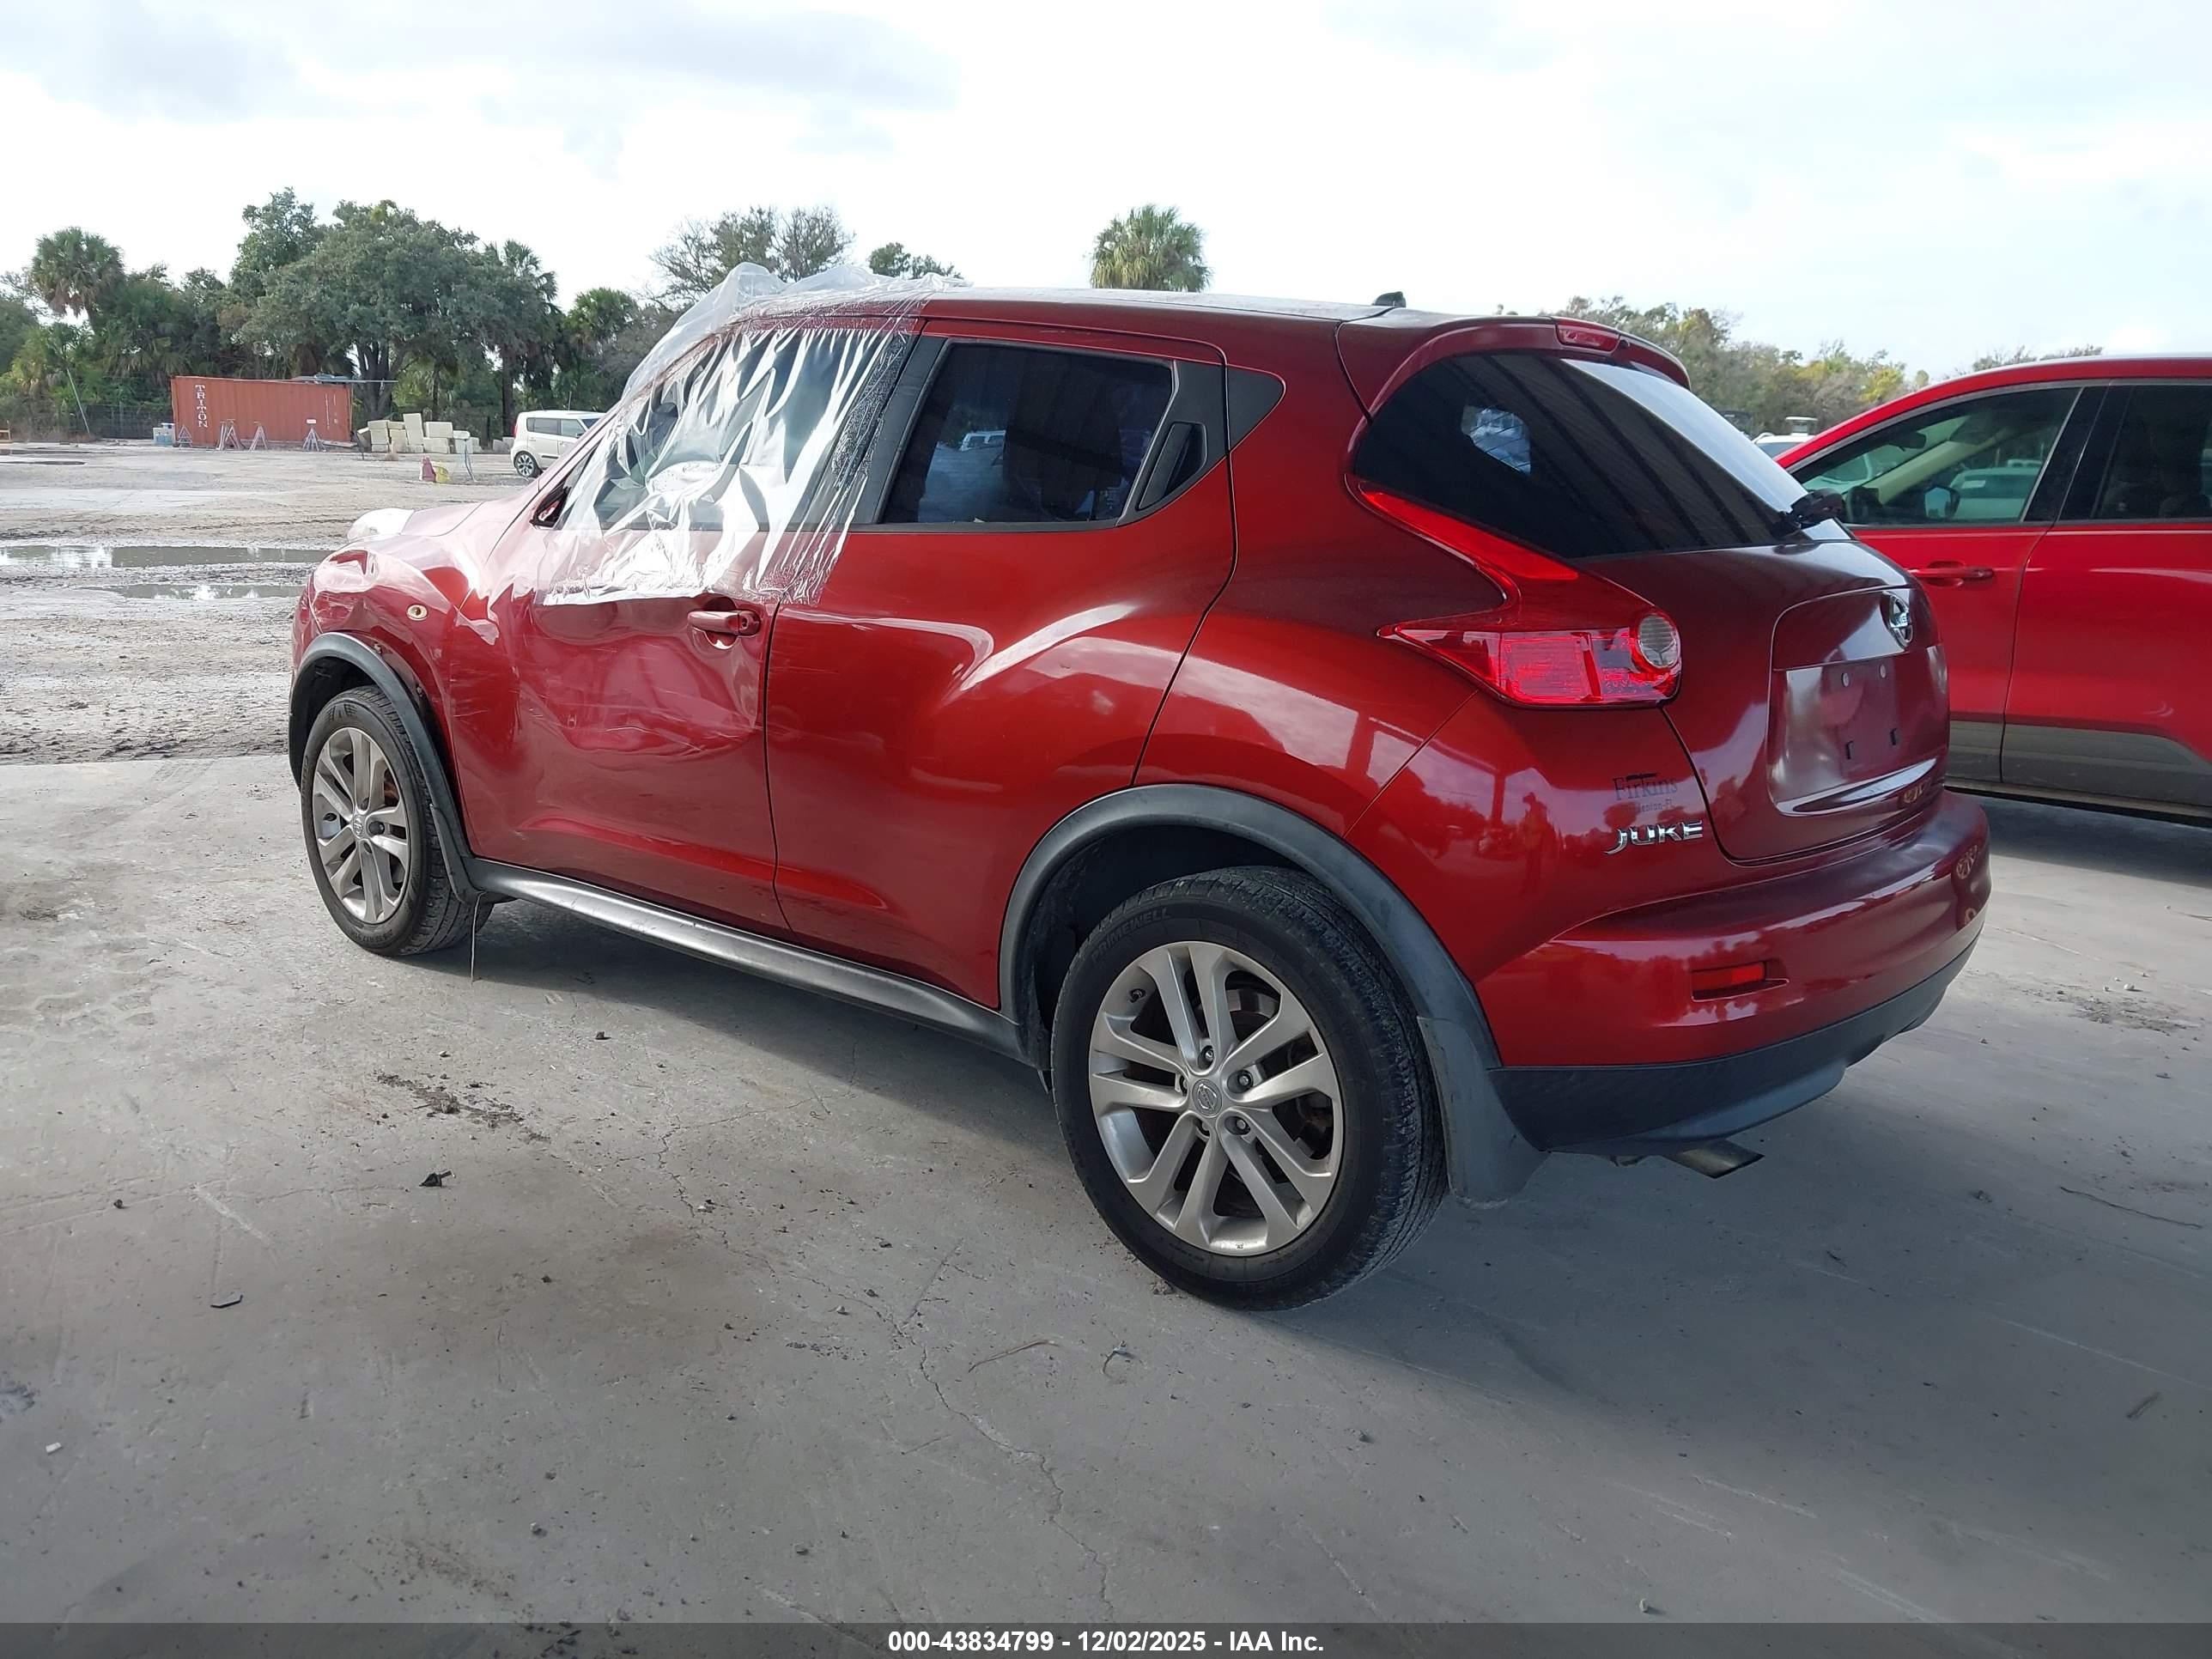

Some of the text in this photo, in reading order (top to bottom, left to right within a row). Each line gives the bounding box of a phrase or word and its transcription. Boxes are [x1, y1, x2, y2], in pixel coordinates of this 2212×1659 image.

[195, 384, 209, 428] TRITON
[1613, 773, 1678, 801] Firkins
[1604, 819, 1704, 854] JUKE
[1091, 907, 1171, 963] PRIMEWELL
